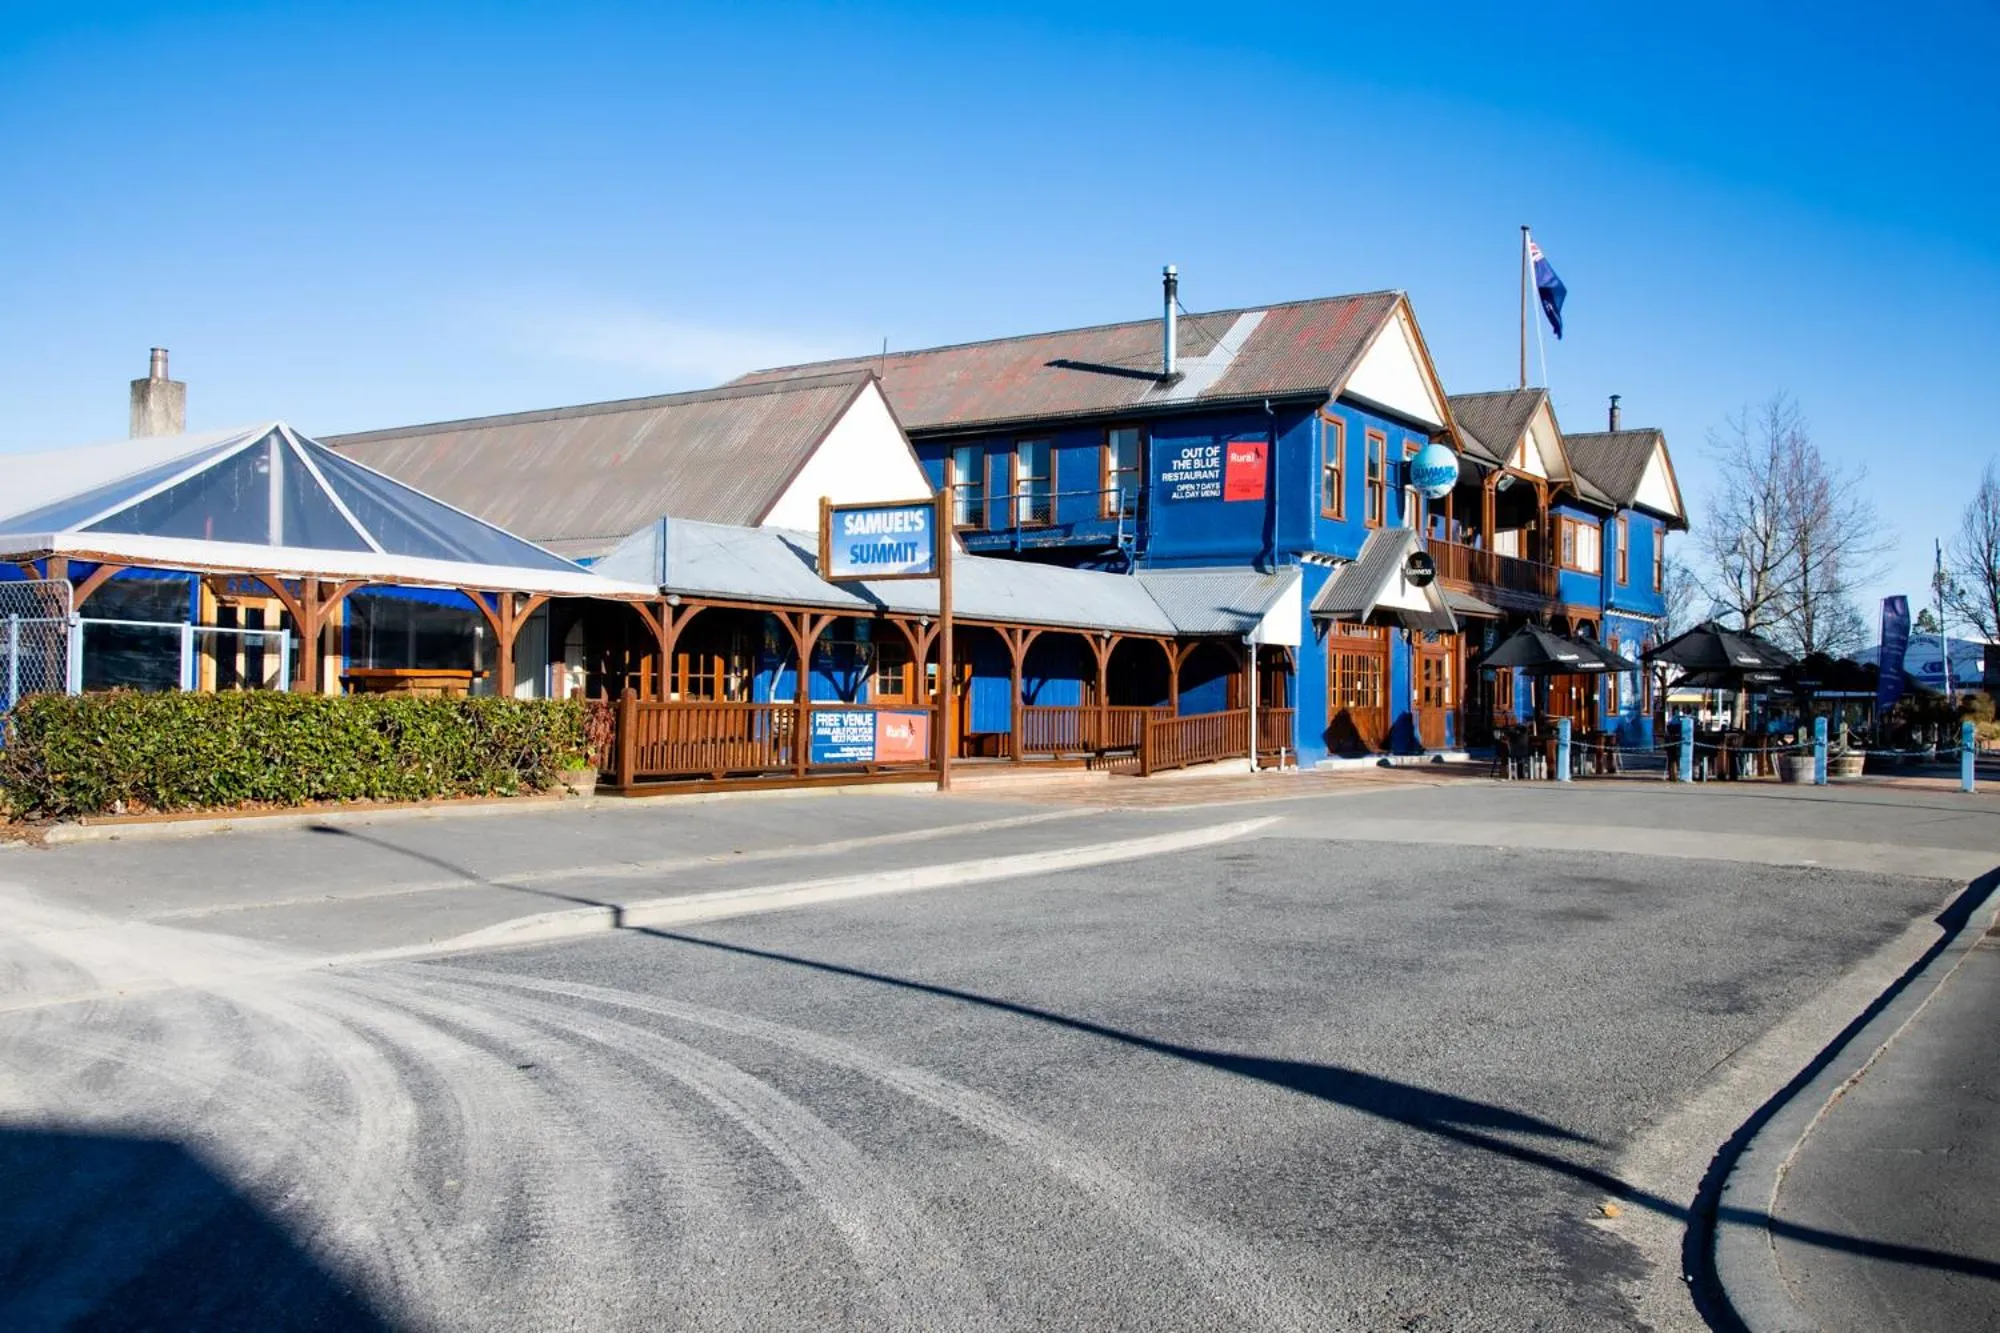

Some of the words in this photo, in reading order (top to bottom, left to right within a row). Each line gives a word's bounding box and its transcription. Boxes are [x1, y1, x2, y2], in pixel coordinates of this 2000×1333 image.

[1181, 447, 1204, 459] OUT
[1205, 446, 1220, 458] OF
[1230, 452, 1255, 463] Rural
[1172, 459, 1192, 471] THE
[1193, 458, 1220, 469] BLUE
[1162, 469, 1220, 482] RESTAURANT
[1176, 484, 1195, 492] OPEN
[1201, 482, 1220, 490] DAYS
[1172, 491, 1184, 499] ALL
[1185, 491, 1199, 499] DAY
[844, 509, 925, 536] SAMUEL'S
[849, 542, 918, 564] SUMMIT
[816, 712, 842, 727] FREE
[842, 712, 873, 727] VENUE
